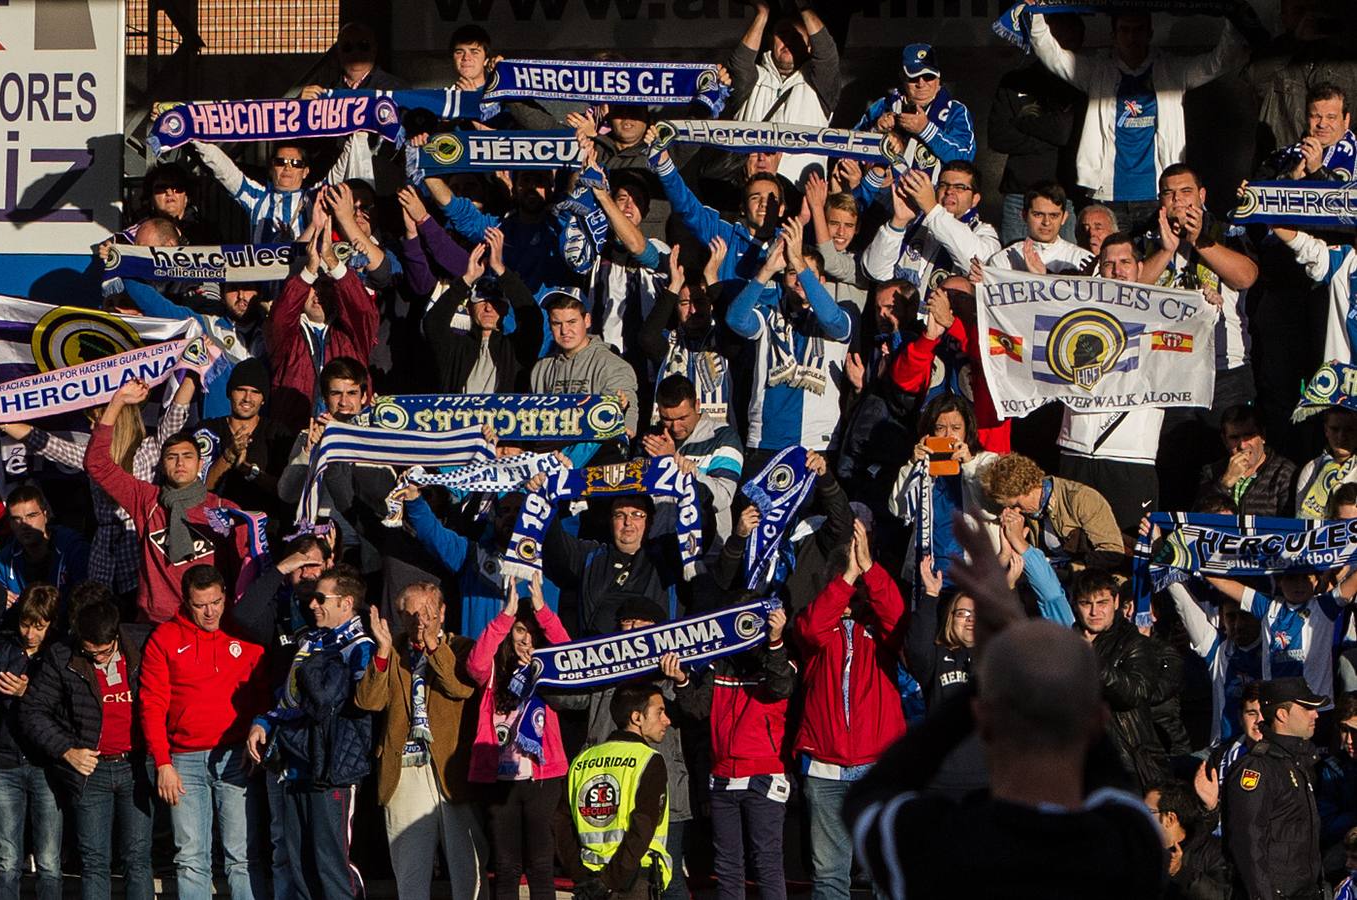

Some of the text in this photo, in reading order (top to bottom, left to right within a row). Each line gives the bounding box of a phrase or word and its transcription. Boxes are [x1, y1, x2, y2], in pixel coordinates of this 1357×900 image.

[513, 65, 631, 95] HERCULES
[636, 71, 675, 95] C.F.
[685, 121, 810, 148] Hercules
[149, 245, 292, 269] hércules
[984, 278, 1198, 322] HERCULES CF
[60, 369, 78, 380] POR
[79, 360, 118, 376] HACERME
[151, 345, 174, 357] LISTA
[0, 355, 178, 413] HERCULANA
[1094, 393, 1139, 407] WALK
[1142, 391, 1192, 405] ALONE
[553, 619, 726, 672] GRACIAS MAMA
[558, 672, 583, 681] POR
[586, 668, 610, 678] SER
[612, 663, 635, 674] DEL
[636, 648, 698, 669] HERLES
[575, 756, 637, 771] SEGURIDAD
